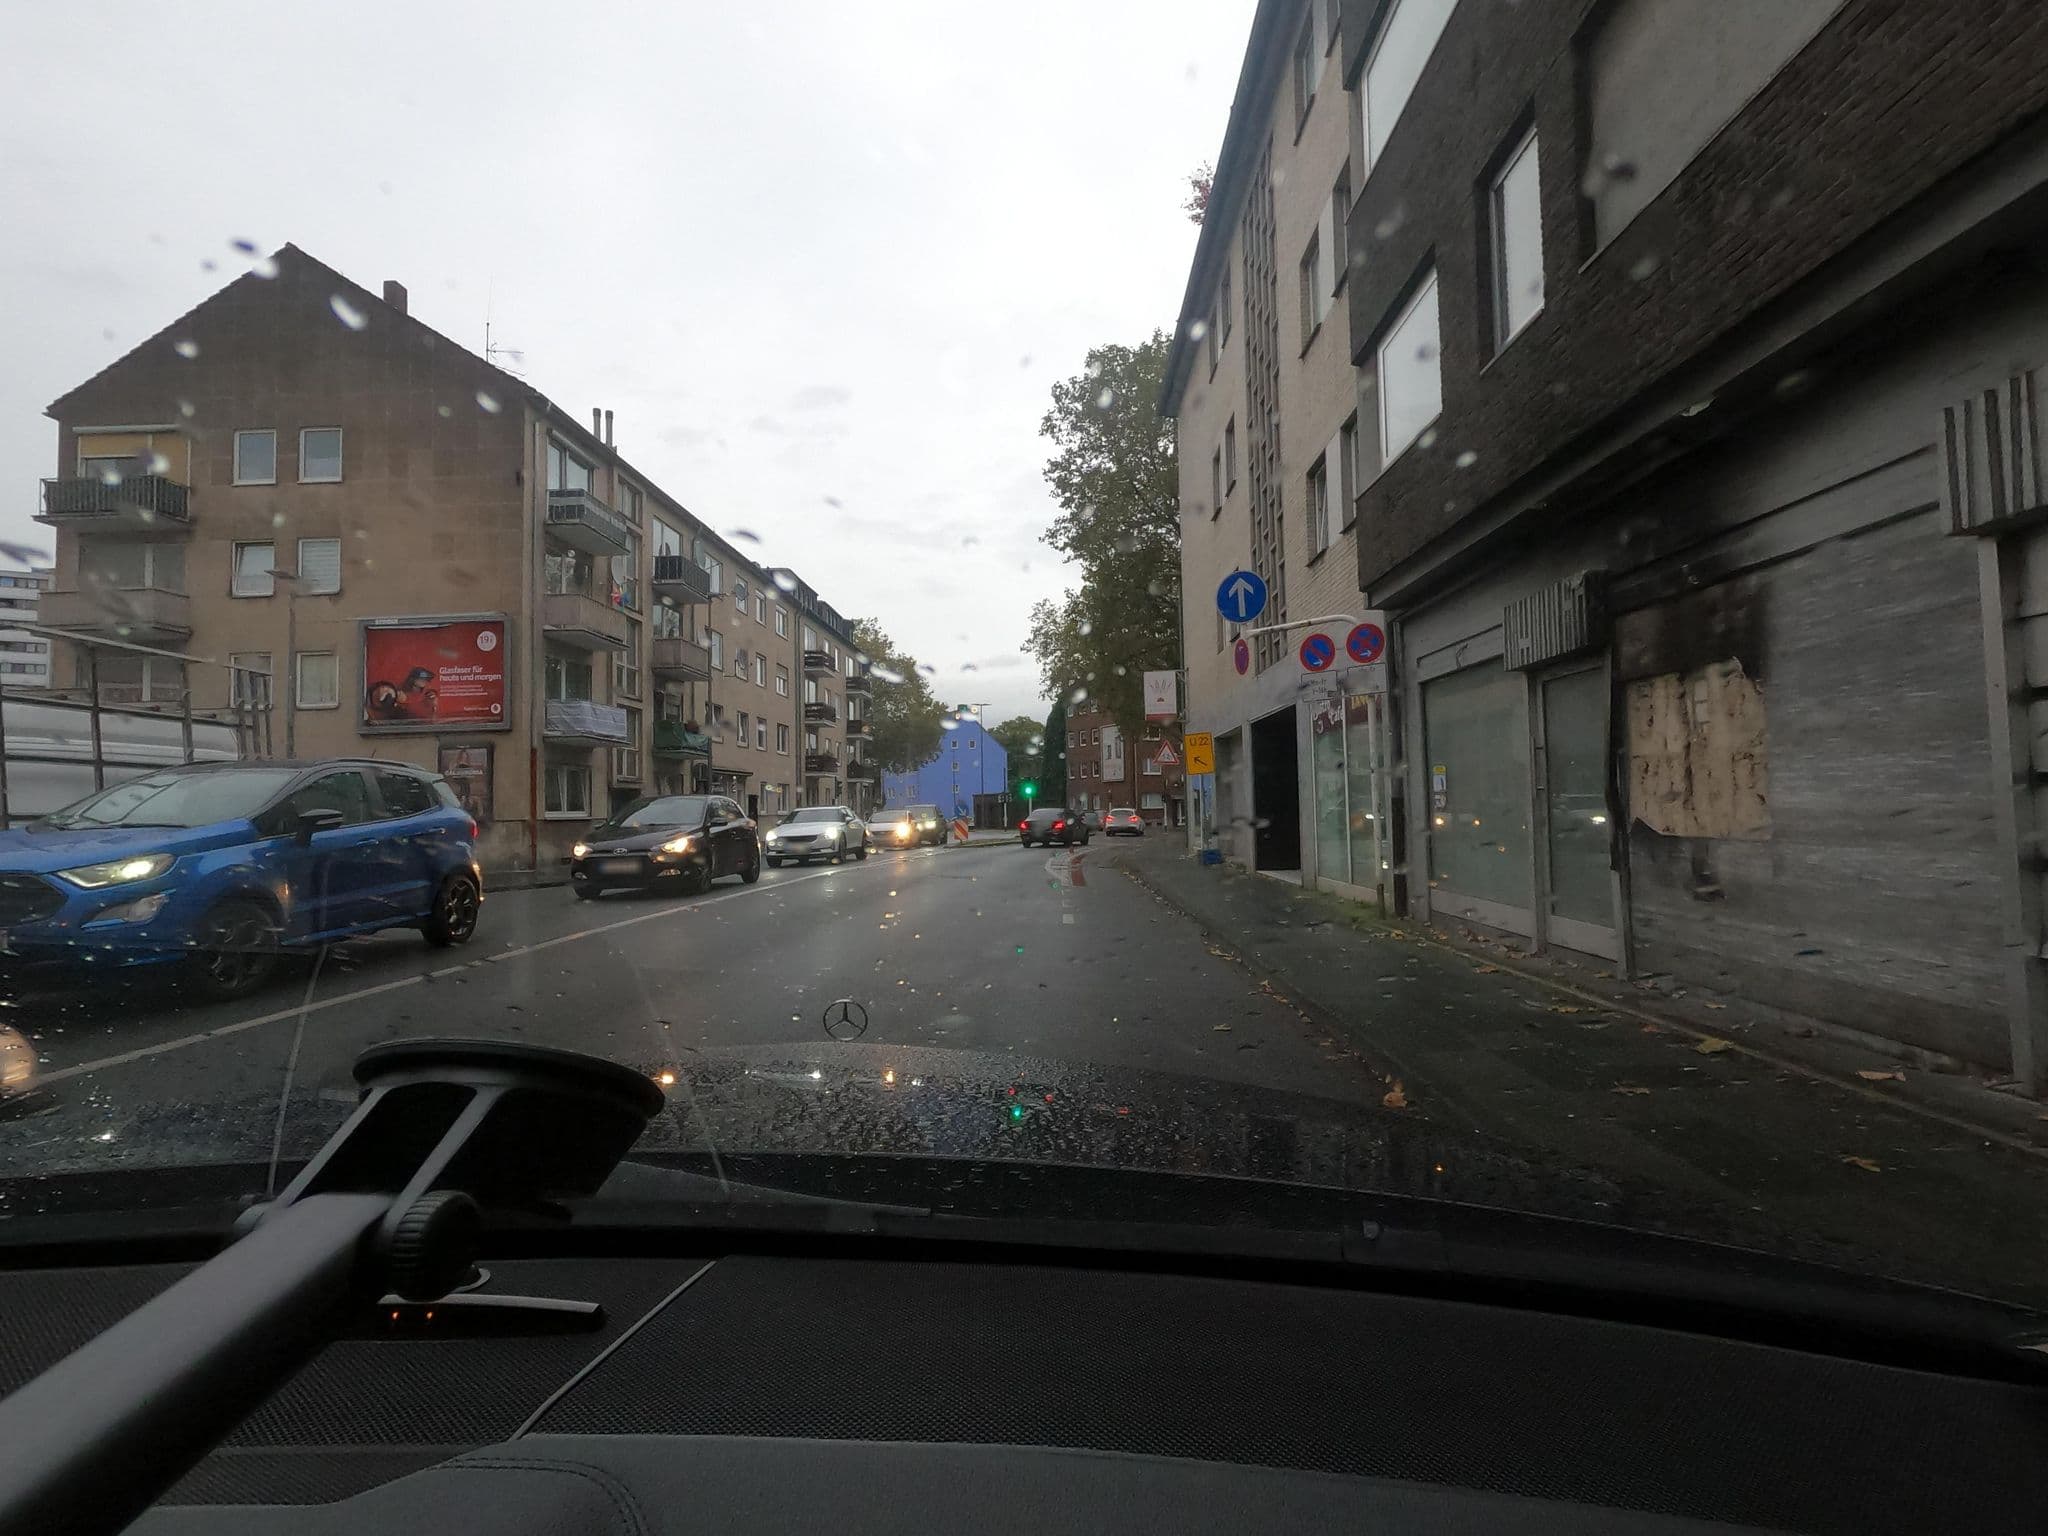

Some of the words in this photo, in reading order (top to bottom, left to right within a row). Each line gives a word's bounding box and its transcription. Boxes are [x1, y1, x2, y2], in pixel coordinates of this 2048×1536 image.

[440, 666, 471, 674] Glasfaser
[472, 665, 483, 673] für
[440, 674, 459, 682] heute
[475, 673, 502, 682] morgen
[1190, 738, 1197, 746] U
[1199, 736, 1209, 746] 22
